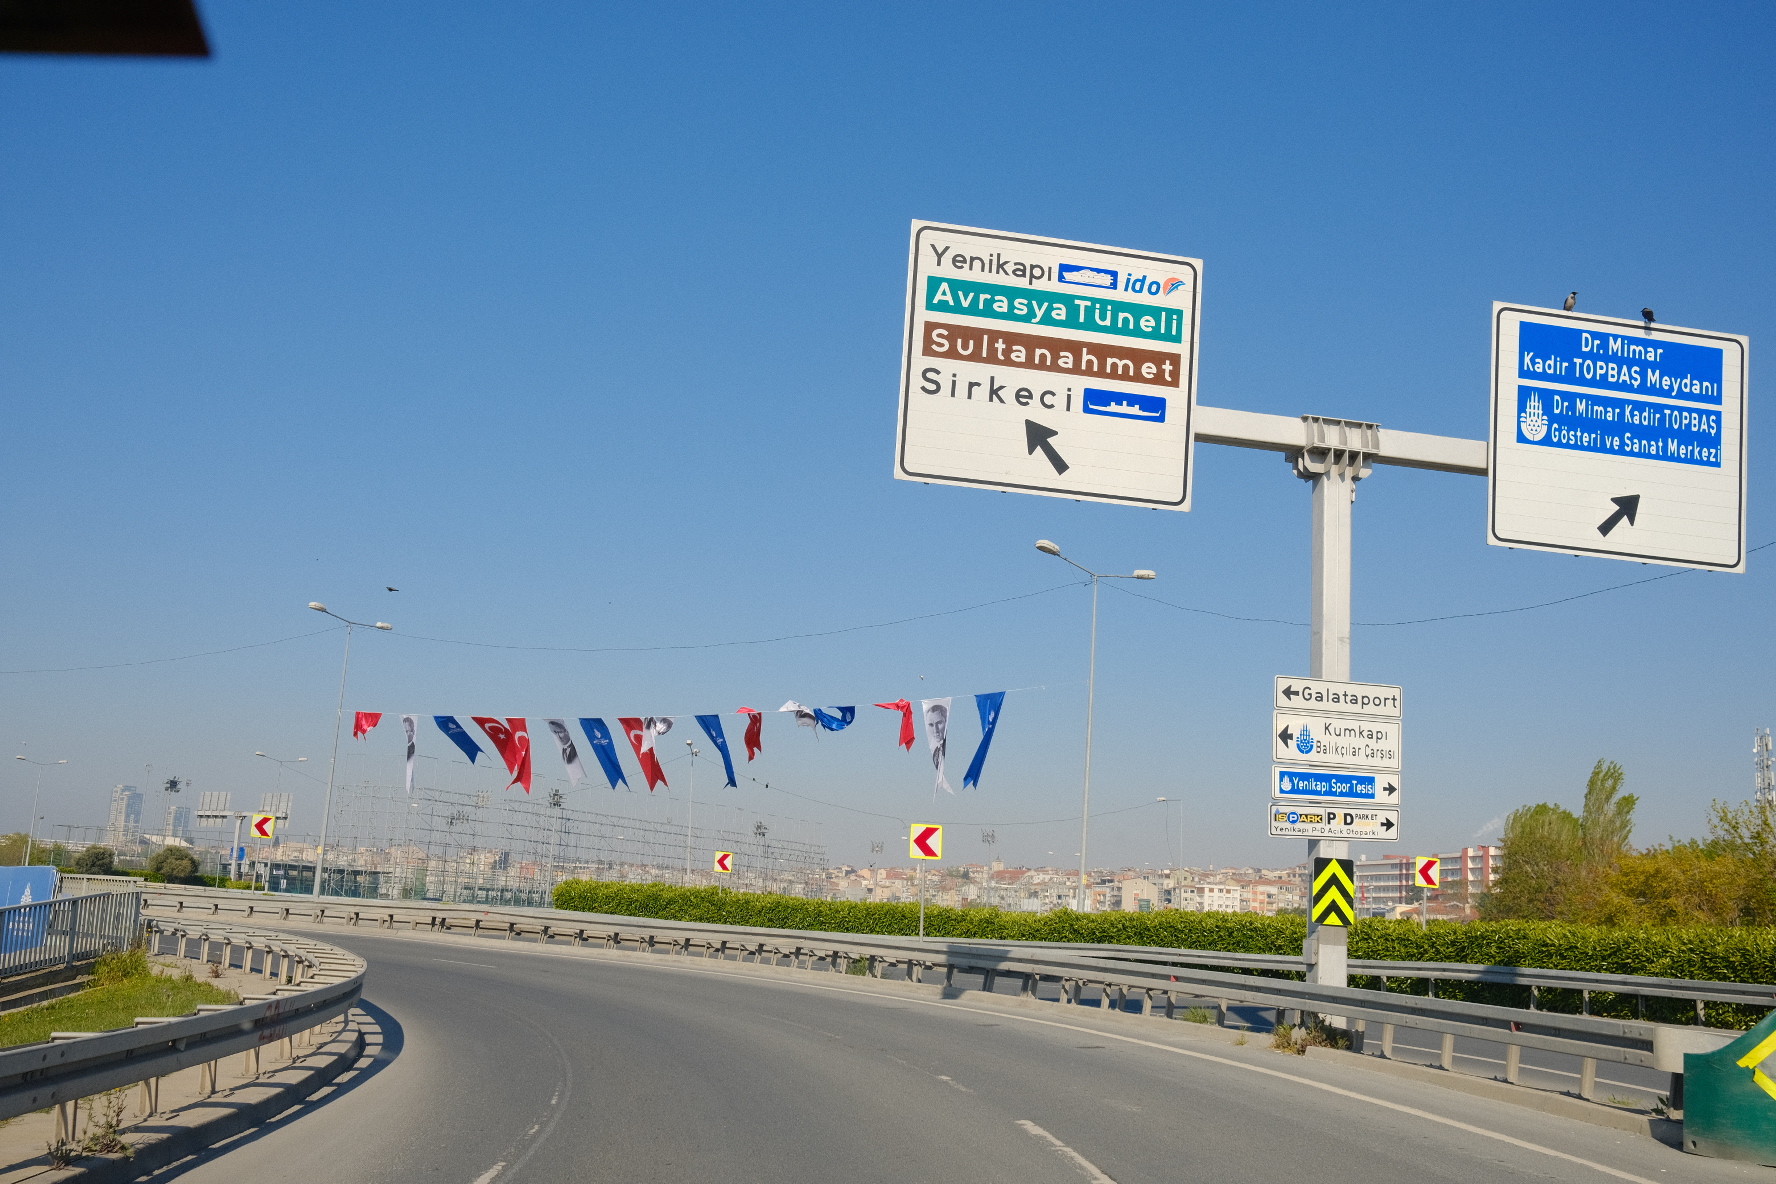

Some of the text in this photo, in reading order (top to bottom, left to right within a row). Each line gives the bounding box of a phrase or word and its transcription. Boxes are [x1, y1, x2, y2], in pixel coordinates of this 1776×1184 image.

[930, 244, 1052, 285] Yenikapı
[932, 282, 1178, 336] Avrasya Tüneli
[931, 329, 1173, 382] Sultanahmet
[1581, 333, 1663, 362] Dr. Mimar
[920, 367, 1072, 412] Sirkeci
[1523, 351, 1718, 396] Kadir TOPBAŞ Meydanı
[1553, 395, 1717, 437] Dr. Mimar Kadir TOPBAŞ
[1551, 423, 1721, 463] Gösteri ve Sanat Merkezi
[1302, 686, 1397, 709] Galataport
[1316, 740, 1361, 758] Balıkçılar
[1324, 722, 1388, 743] Kumkapı
[1293, 776, 1375, 795] Yenikapı Spor Tesisi
[1355, 813, 1369, 821] PARK
